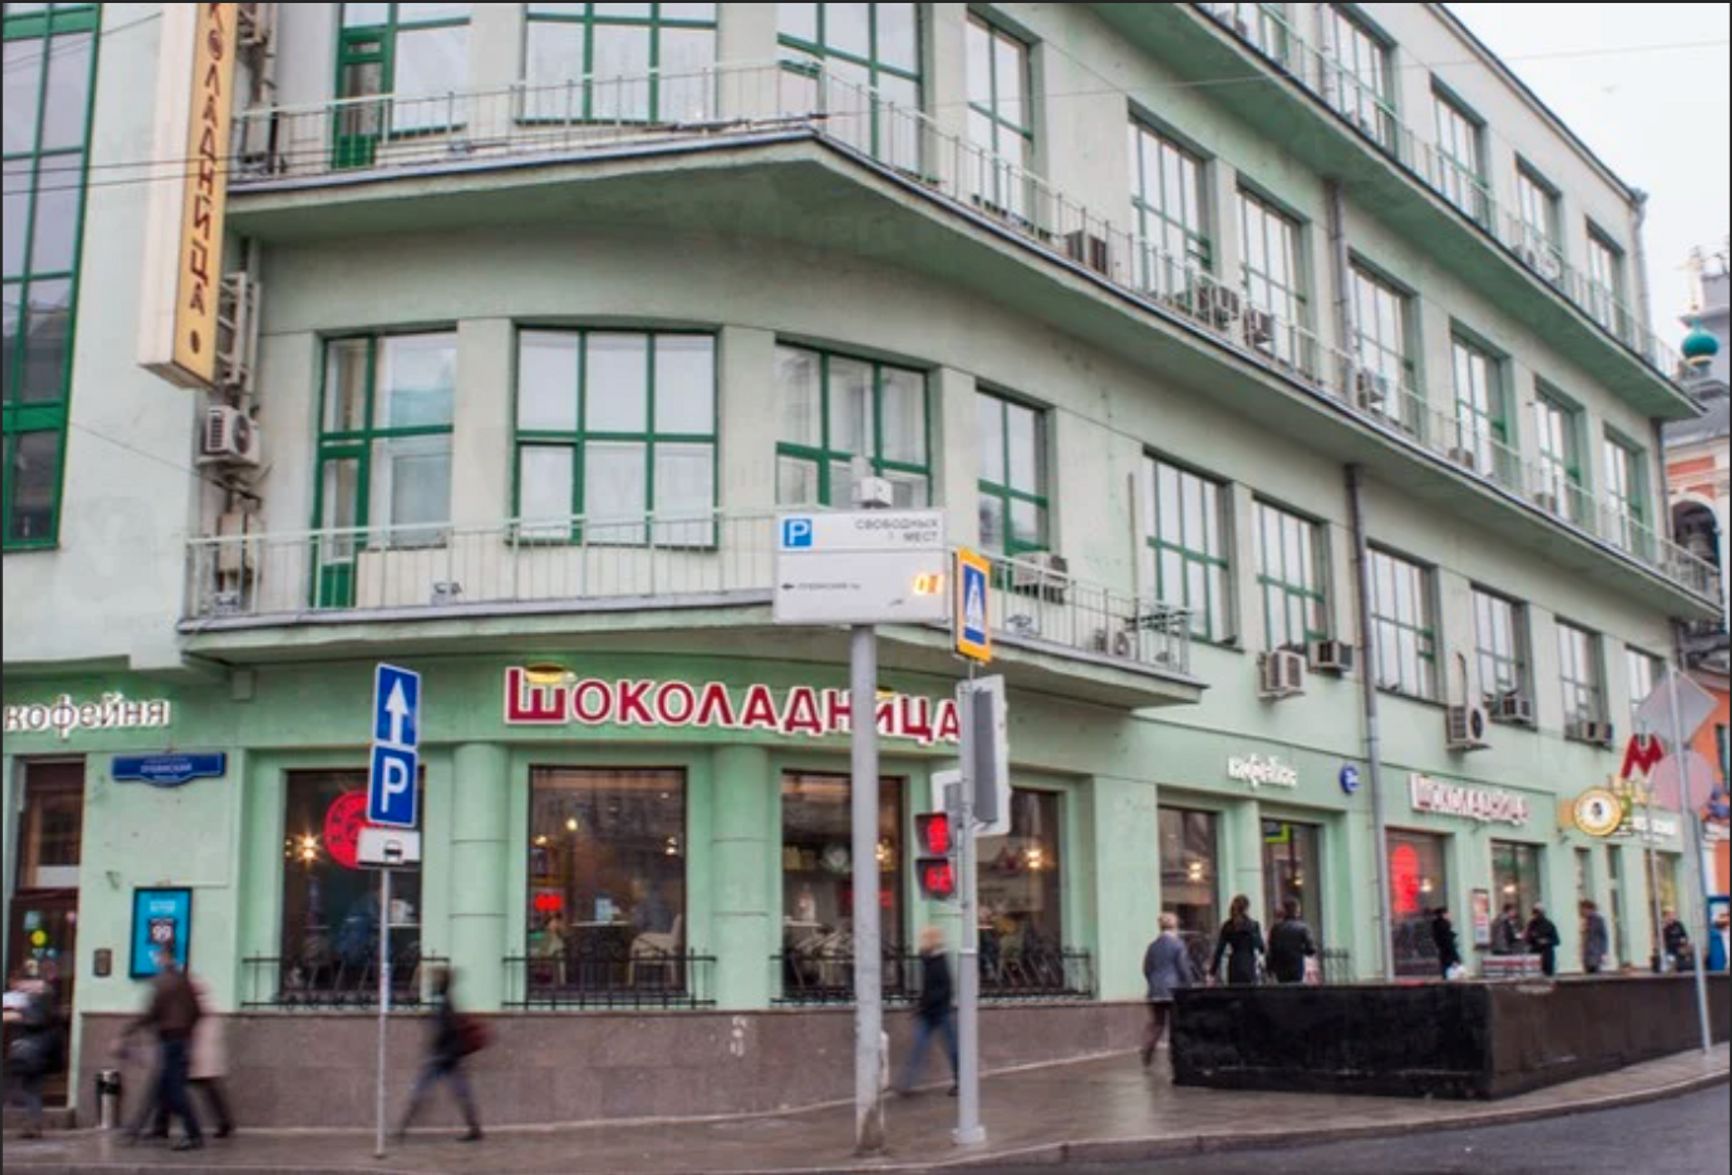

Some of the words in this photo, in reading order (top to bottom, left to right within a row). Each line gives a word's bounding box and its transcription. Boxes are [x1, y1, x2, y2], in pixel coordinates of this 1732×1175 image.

[854, 518, 940, 530] СВОБОДНЫХ
[903, 531, 940, 543] МЕСТ
[4, 691, 171, 742] кофейня
[381, 756, 409, 813] P
